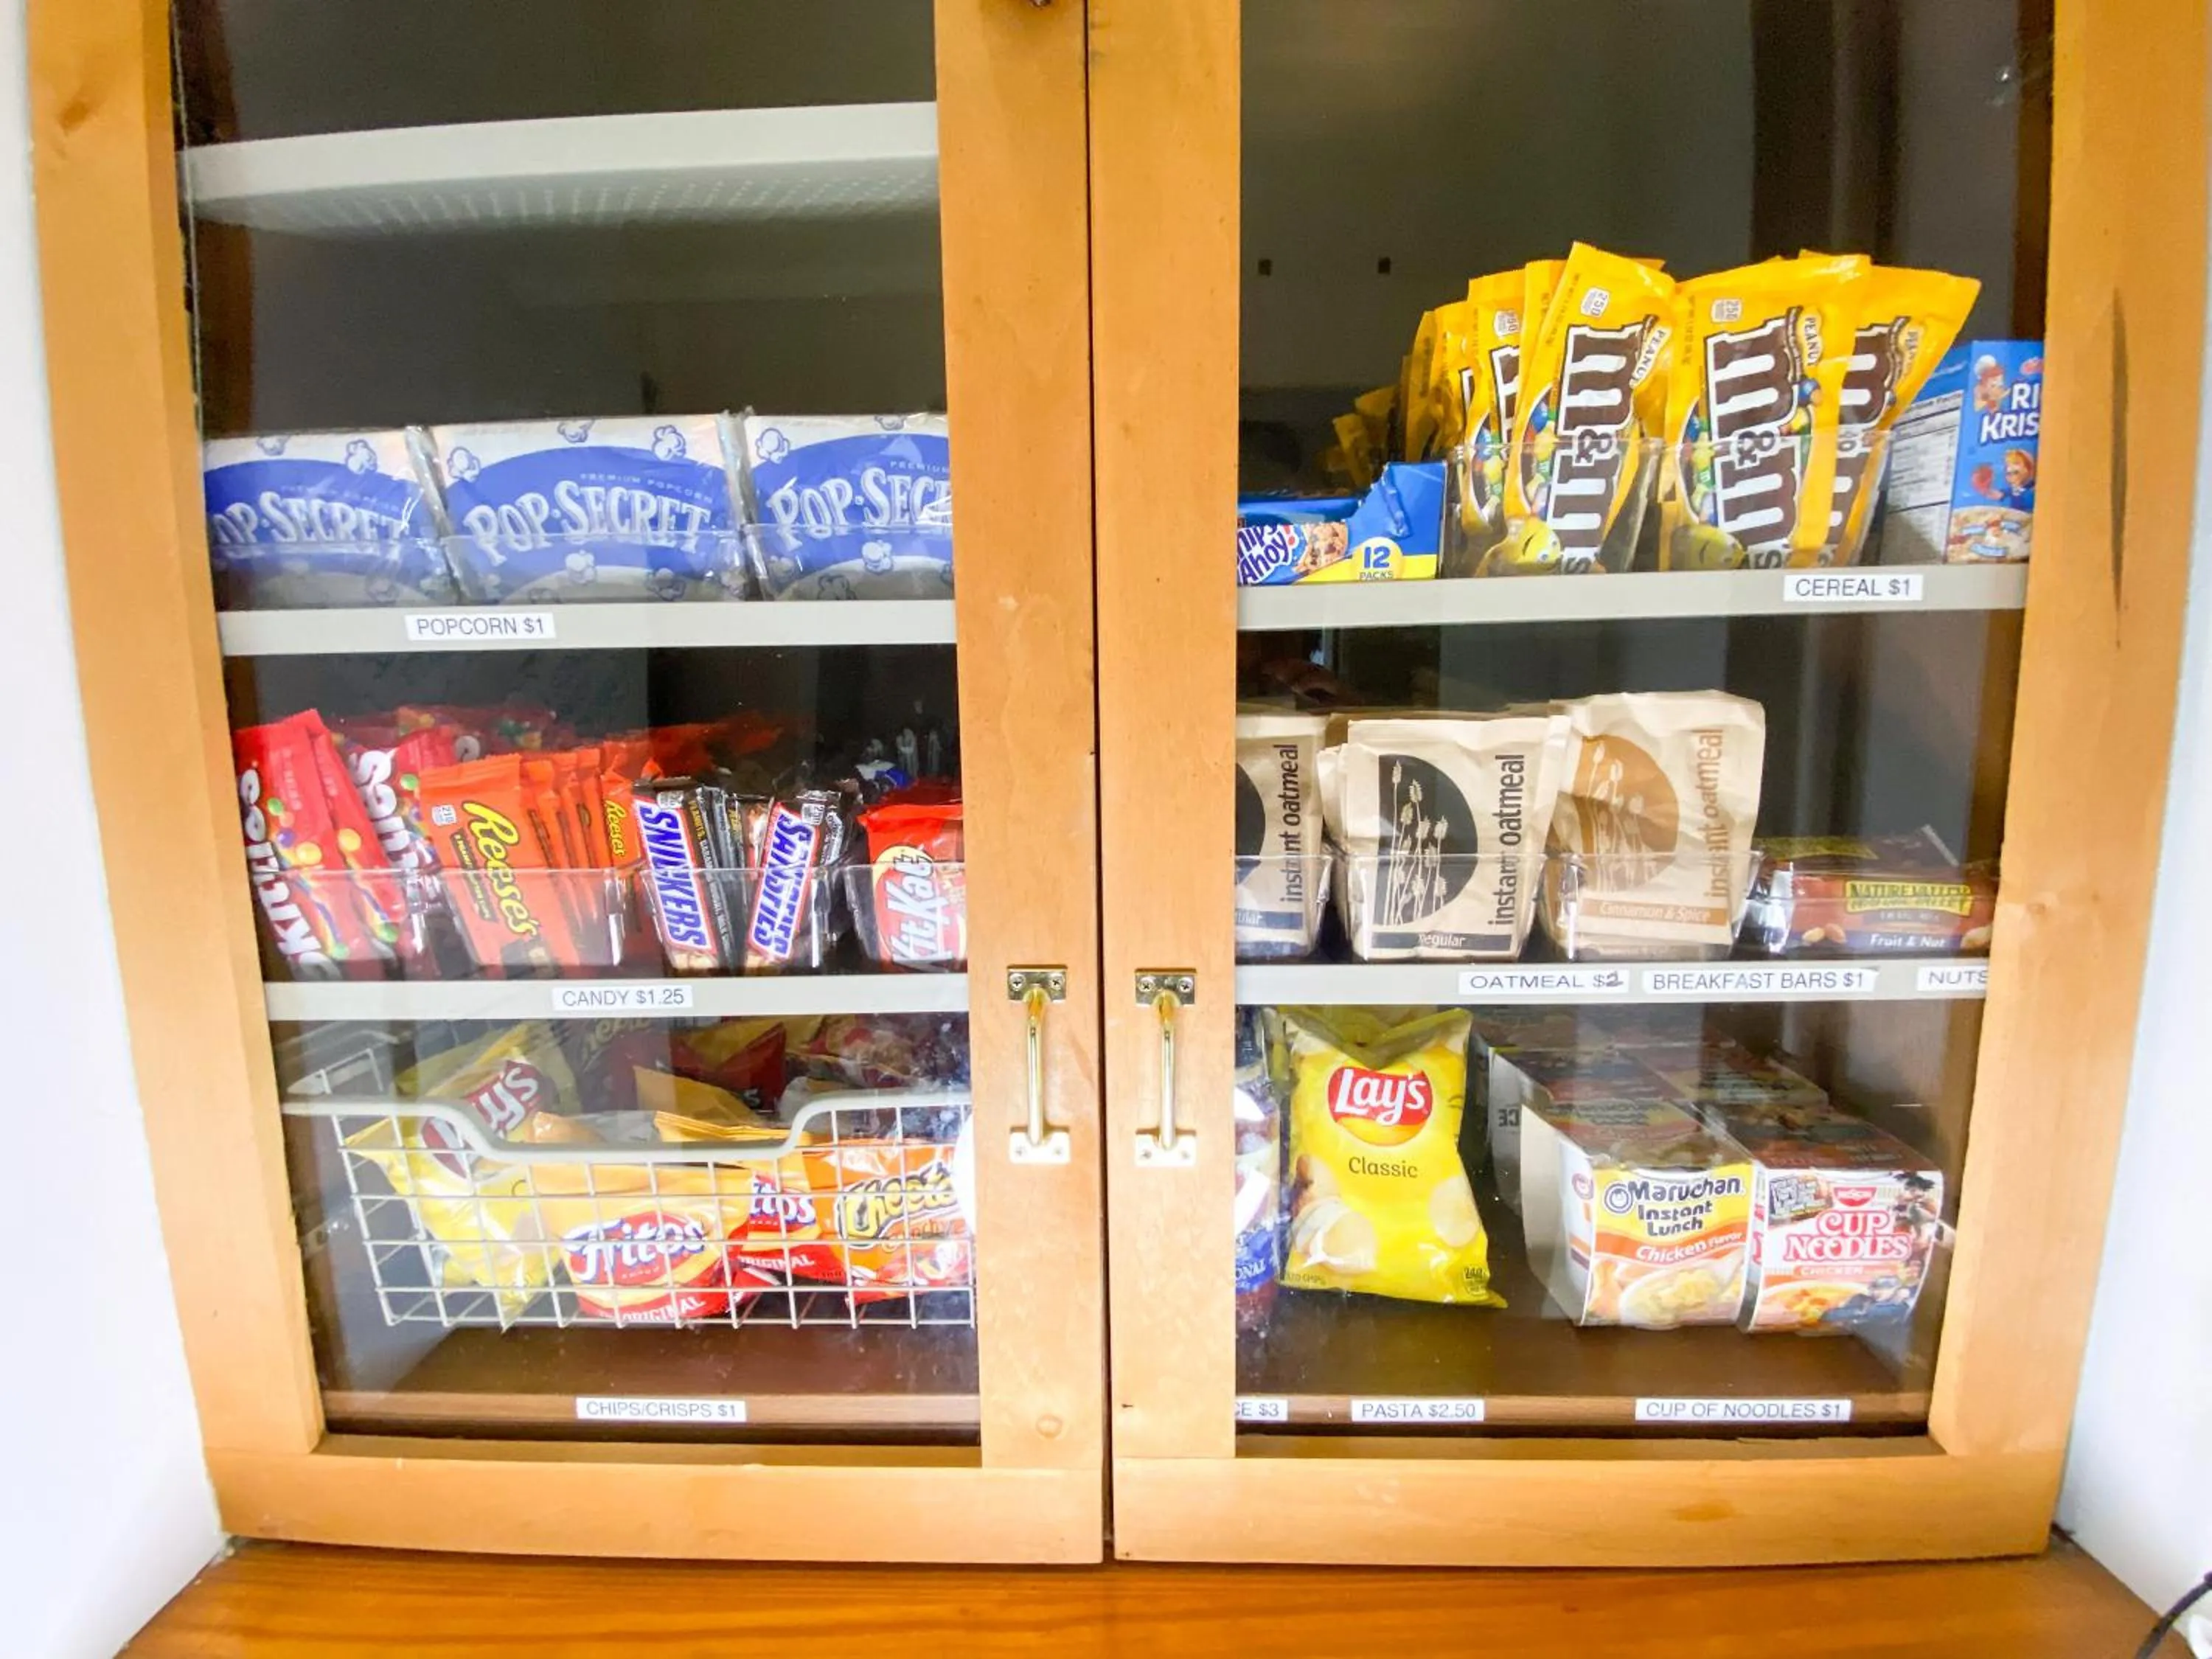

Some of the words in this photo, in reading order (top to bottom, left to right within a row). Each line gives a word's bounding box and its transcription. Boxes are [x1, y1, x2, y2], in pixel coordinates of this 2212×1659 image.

[1364, 546, 1391, 568] 12
[1359, 571, 1394, 581] PACKS
[1795, 578, 1882, 597] CEREAL
[1888, 578, 1910, 596] $1
[417, 616, 518, 636] POPCORN
[524, 616, 544, 634] $1
[1691, 728, 1723, 818] oatmeal
[1273, 744, 1301, 827] oatmeal
[1492, 754, 1525, 846] oatmeal
[1870, 933, 1902, 947] Fruit
[1920, 934, 1947, 947] Nut
[1470, 975, 1584, 989] OATMEAL
[1593, 970, 1624, 988] $2
[1652, 973, 1773, 990] BREAKFAST
[1781, 972, 1837, 989] BARS
[1843, 972, 1864, 988] $1
[562, 990, 630, 1006] CANDY
[636, 988, 685, 1005] $1.25
[1335, 1068, 1427, 1127] Lay's
[1349, 1155, 1419, 1179] Classic
[1627, 1178, 1741, 1202] Maruchan
[1638, 1200, 1714, 1222] Instant
[1647, 1218, 1703, 1237] Lunch
[1817, 1211, 1890, 1237] CUP
[560, 1216, 707, 1284] Fritos
[1635, 1240, 1708, 1263] Chicken
[1784, 1234, 1911, 1262] NOODLES
[586, 1400, 712, 1418] CHIPS/CRISPS
[717, 1404, 736, 1417] $1
[1258, 1402, 1279, 1417] $3
[1362, 1402, 1423, 1418] PASTA
[1428, 1402, 1476, 1418] $2.50
[1646, 1402, 1686, 1417] CUP
[1691, 1402, 1719, 1416] OF
[1723, 1402, 1816, 1418] NOODLES
[1821, 1402, 1841, 1417] $1
